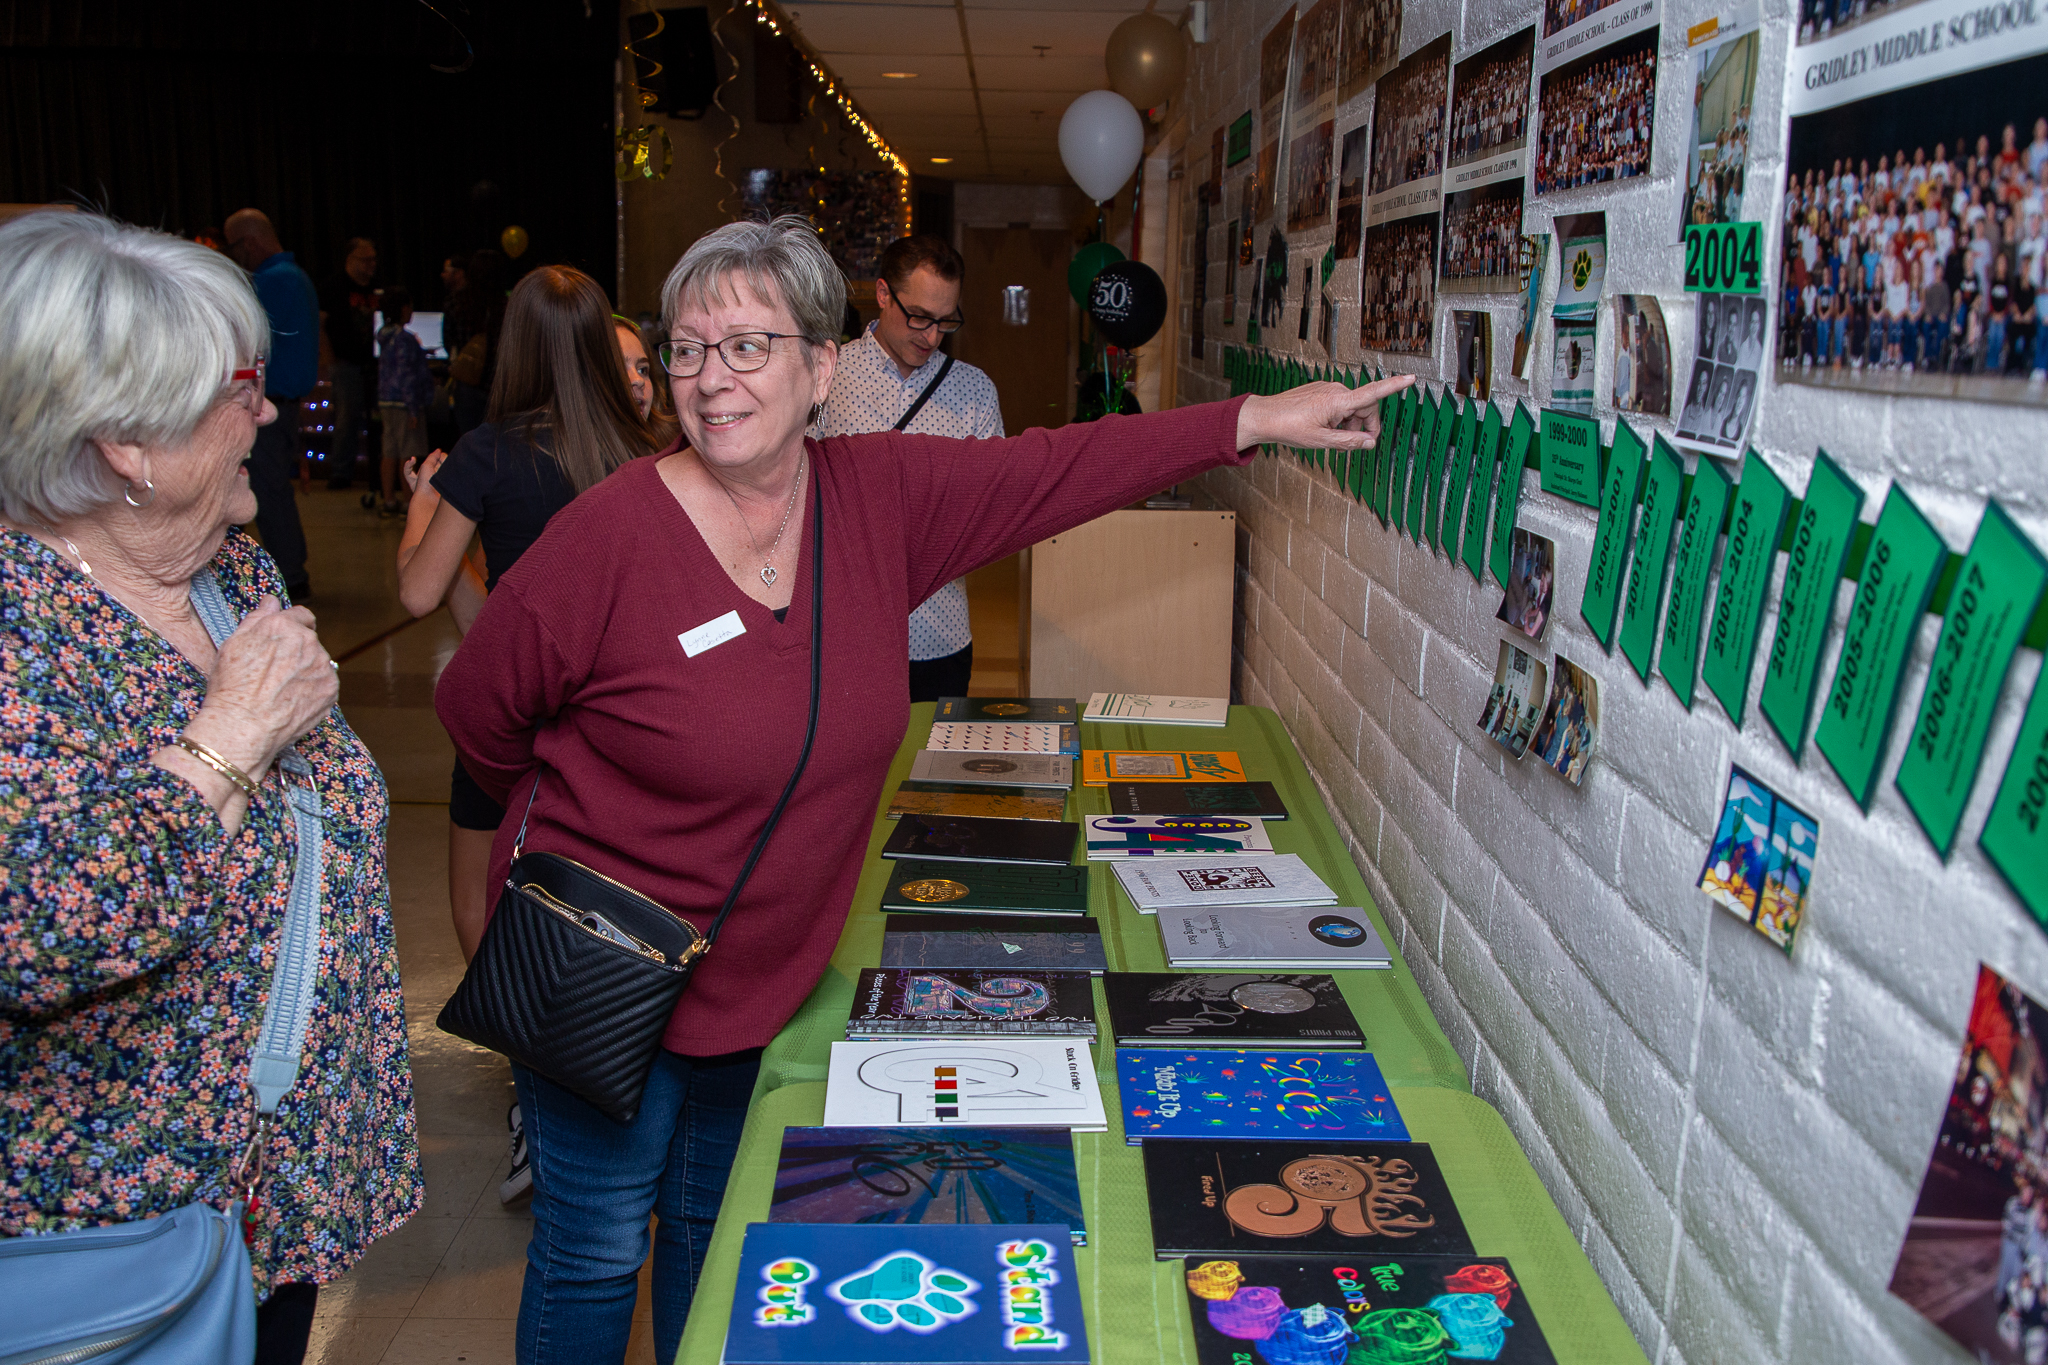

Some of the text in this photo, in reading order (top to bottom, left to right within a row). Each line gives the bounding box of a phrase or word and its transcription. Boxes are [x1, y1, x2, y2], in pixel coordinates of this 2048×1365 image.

[1546, 40, 1566, 59] GRIDLEY
[1566, 30, 1585, 50] MIDDLE
[1585, 20, 1606, 41] SCHOOL
[1611, 10, 1631, 29] CLASS
[1630, 6, 1640, 21] OF
[1639, 1, 1653, 17] 1999
[1805, 0, 2037, 90] GRIDLEY MIDDLE SCHOOL
[615, 125, 673, 181] 50
[1493, 163, 1505, 175] CLASS
[1408, 191, 1421, 207] CLASS
[1421, 190, 1428, 203] OF
[1684, 226, 1759, 289] 2004
[1095, 280, 1127, 308] 50
[1548, 421, 1588, 447] 1999-2000
[1445, 422, 1465, 526] 1996-1997
[1467, 431, 1488, 538] 1997-1998
[1559, 456, 1585, 474] Anniversary
[1493, 435, 1514, 547] 1998-1999
[1595, 466, 1624, 598] 2000-2001
[1627, 477, 1659, 620] 2001-2002
[1667, 494, 1701, 647] 2002-2003
[1714, 500, 1753, 658] 2003-2004
[1773, 504, 1817, 679] 2004-2005
[1834, 538, 1892, 721] 2005-2006
[1917, 563, 1987, 762] 2006-2007
[1128, 786, 1140, 811] PAW PRINTS
[1184, 871, 1204, 891] DONE
[1248, 867, 1267, 884] BEEN
[1182, 918, 1198, 945] Looking Back
[1208, 914, 1229, 949] Looking Forward
[860, 1013, 907, 1021] TWO
[1046, 1014, 1092, 1022] TWO
[1145, 1003, 1245, 1034] 2000
[1299, 1028, 1358, 1037] PAW PRINTS
[1065, 1047, 1081, 1091] Stuck On Gridley
[1157, 1092, 1180, 1103] It
[1157, 1101, 1182, 1118] Up
[1260, 1058, 1347, 1130] 2003
[1200, 1175, 1216, 1207] Fired Up
[760, 1258, 813, 1325] Out
[1000, 1240, 1062, 1349] Stand
[1332, 1267, 1371, 1314] Colors
[1370, 1262, 1405, 1292] True
